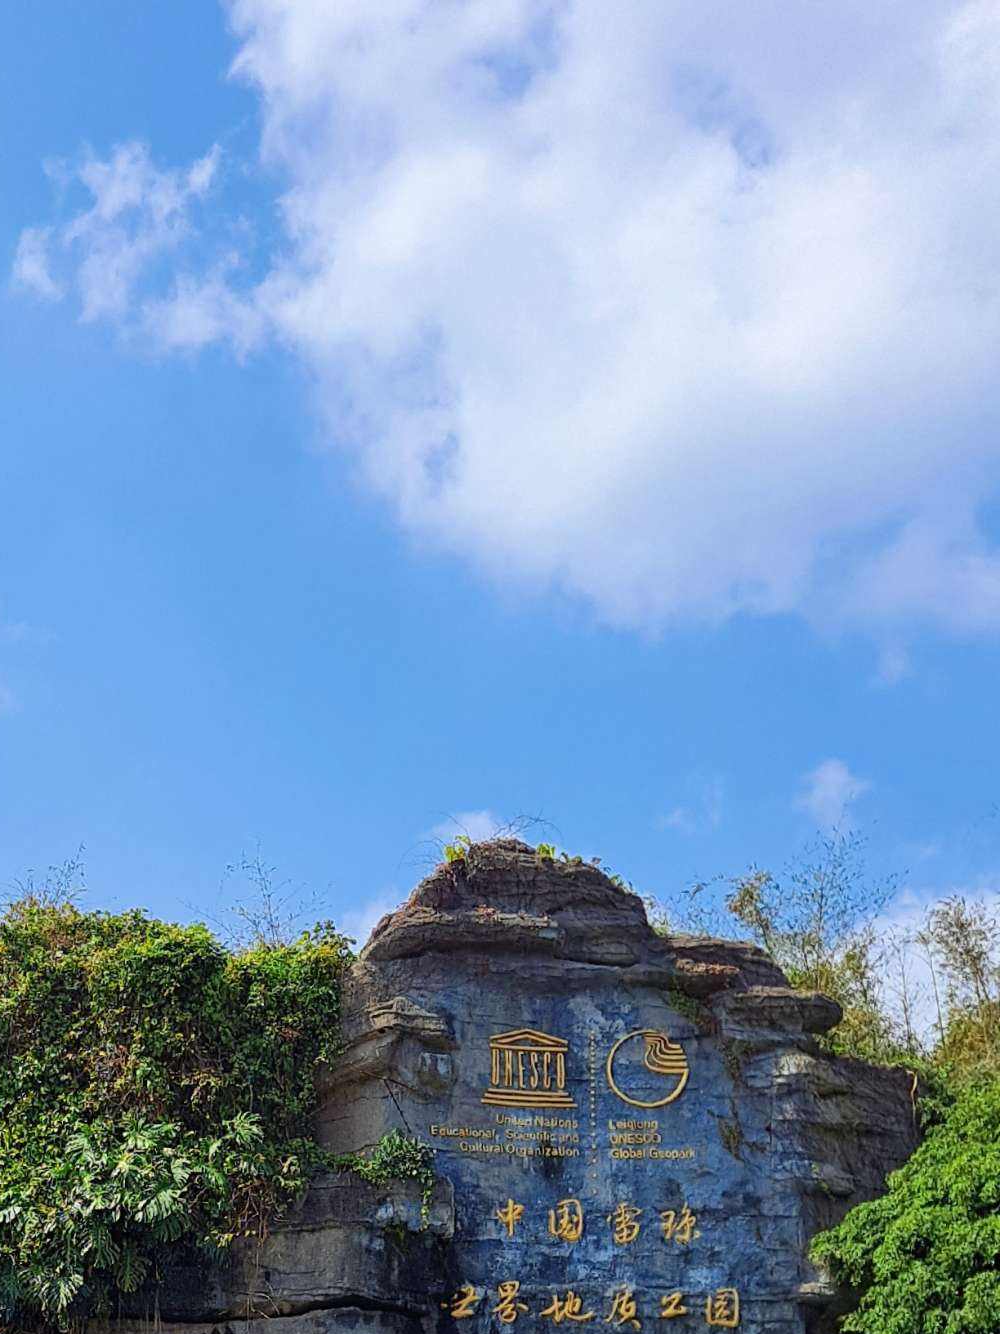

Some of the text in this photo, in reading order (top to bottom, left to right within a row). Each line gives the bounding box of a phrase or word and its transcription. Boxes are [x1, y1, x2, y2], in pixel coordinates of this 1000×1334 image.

[490, 1048, 566, 1089] UNESCO
[496, 1114, 578, 1129] United Nations
[505, 1129, 555, 1141] Scientific
[558, 1134, 579, 1143] and
[609, 1133, 662, 1145] UNESCO
[460, 1141, 580, 1158] Cultural Organization
[610, 1148, 696, 1160] Global Geopark
[440, 1281, 742, 1330] 世界地质公园
